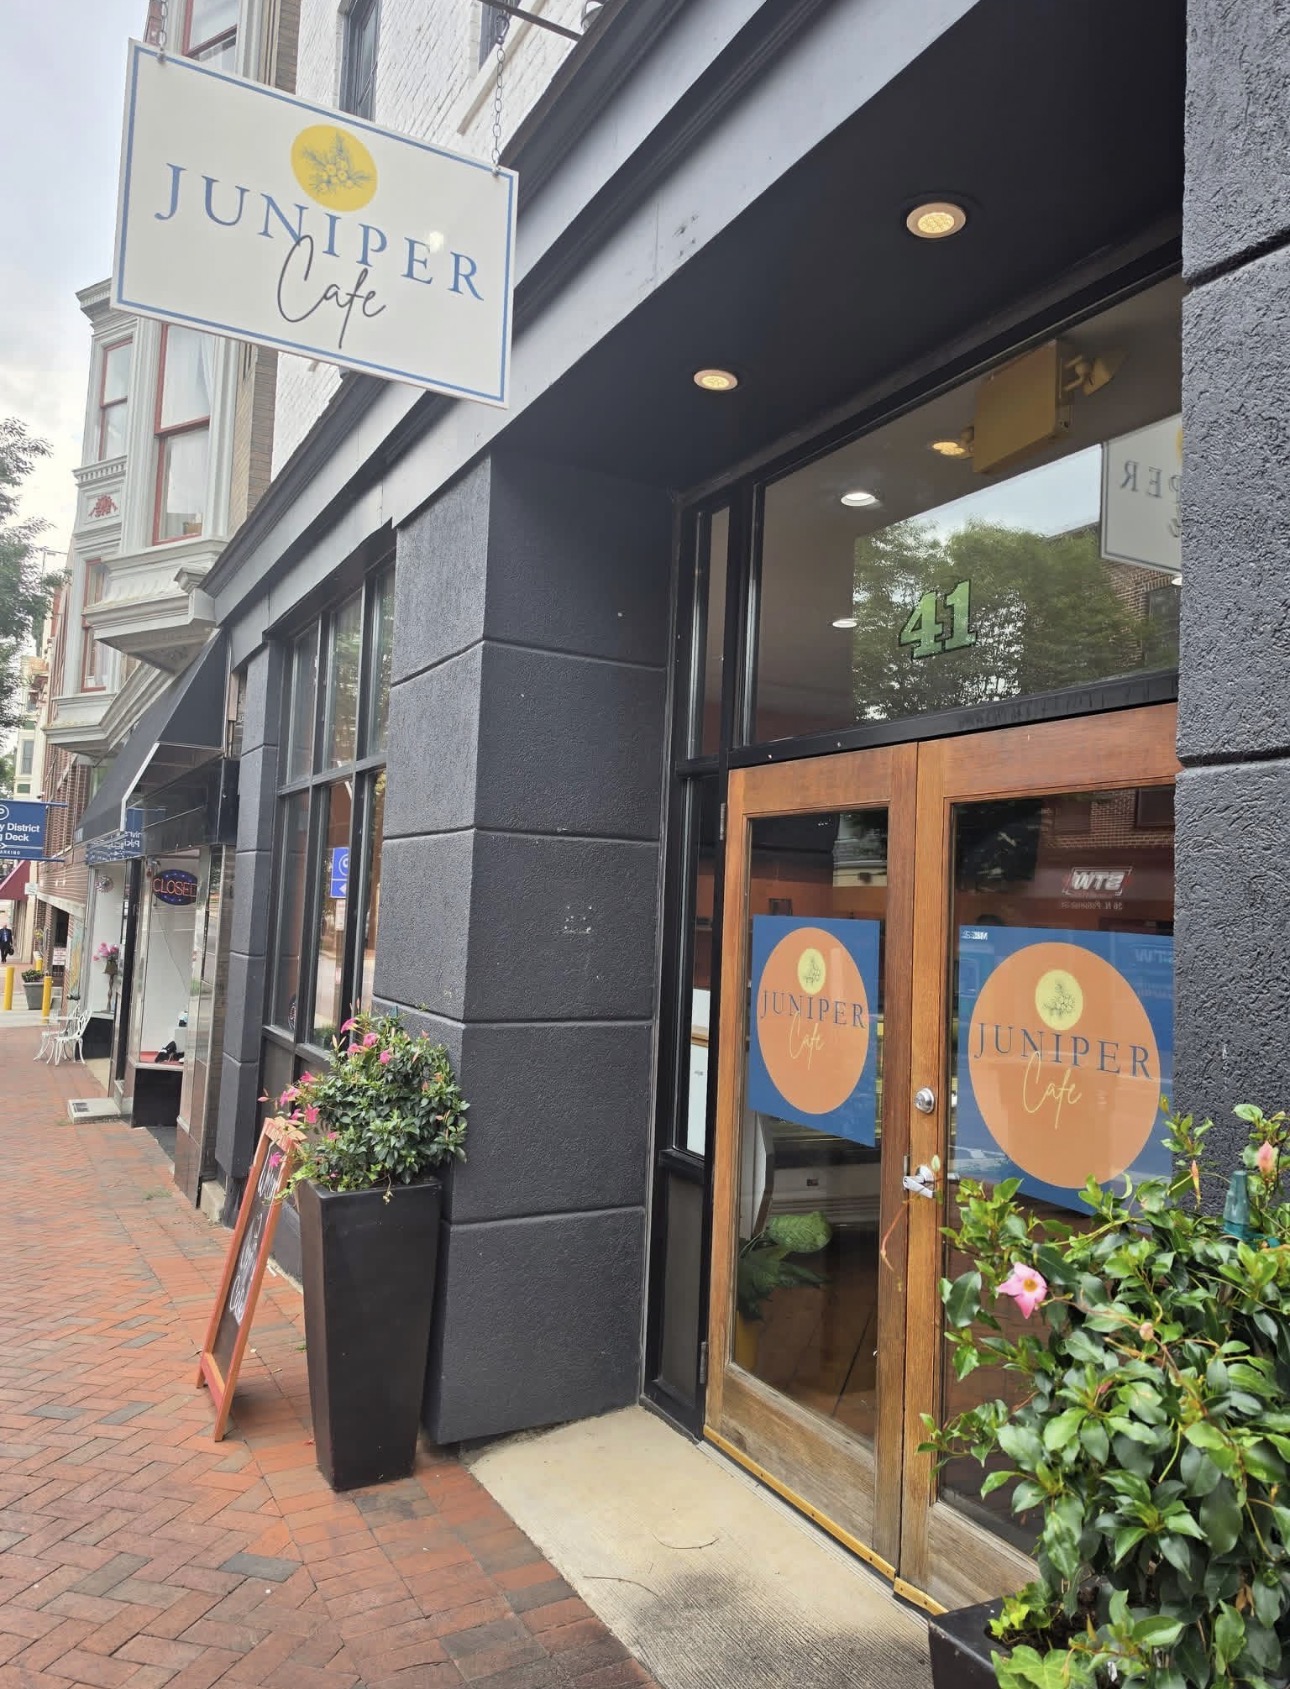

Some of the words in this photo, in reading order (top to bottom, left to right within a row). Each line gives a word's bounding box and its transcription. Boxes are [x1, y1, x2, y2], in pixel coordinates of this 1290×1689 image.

[154, 163, 485, 301] JUNIPER
[277, 235, 387, 349] Cafe
[899, 579, 977, 660] 41
[5, 832, 29, 842] Deck
[7, 822, 40, 833] District
[760, 990, 866, 1029] JUNIPER
[788, 1010, 826, 1071] Cafe
[974, 1022, 1153, 1080] JUNIPER
[1022, 1051, 1082, 1129] Cafe
